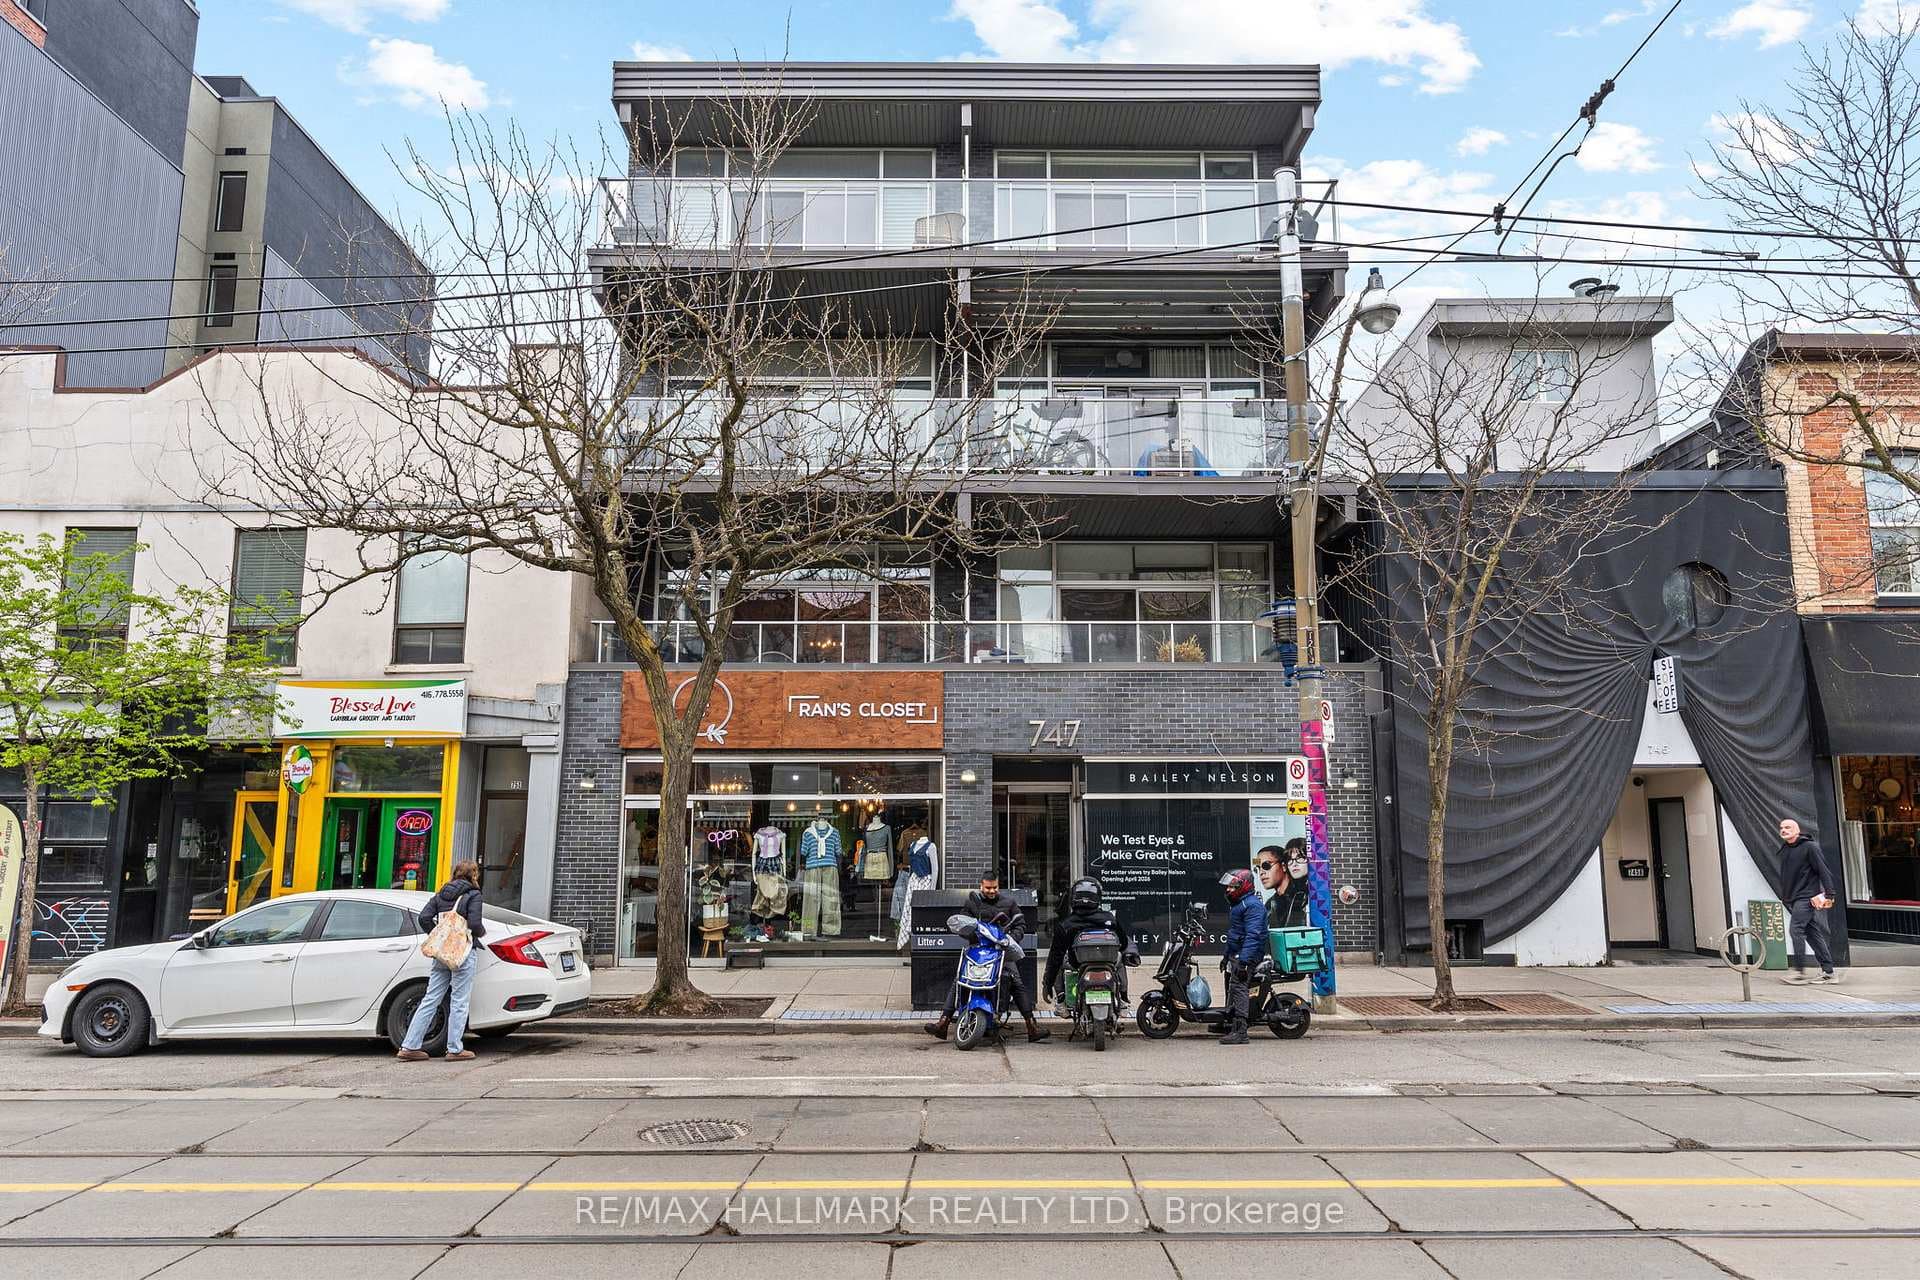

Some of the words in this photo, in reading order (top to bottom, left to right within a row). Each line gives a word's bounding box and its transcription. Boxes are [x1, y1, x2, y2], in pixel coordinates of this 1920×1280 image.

[420, 689, 464, 699] 416.778.5558
[330, 696, 384, 714] Blessed
[386, 695, 416, 715] Love
[799, 702, 851, 717] RAN'S
[858, 702, 927, 717] CLOSET
[1029, 720, 1082, 748] 747
[1129, 773, 1190, 783] BAILEY
[1208, 773, 1275, 783] NELSON
[400, 816, 430, 829] OPEN
[707, 829, 739, 849] open
[1101, 834, 1120, 845] We
[1122, 834, 1146, 845] Test
[1148, 834, 1174, 847] Eyes
[1176, 834, 1185, 845] &
[1101, 849, 1132, 860] Make
[1135, 849, 1169, 860] Great
[1172, 849, 1214, 860] Frames
[917, 937, 936, 946] Litter
